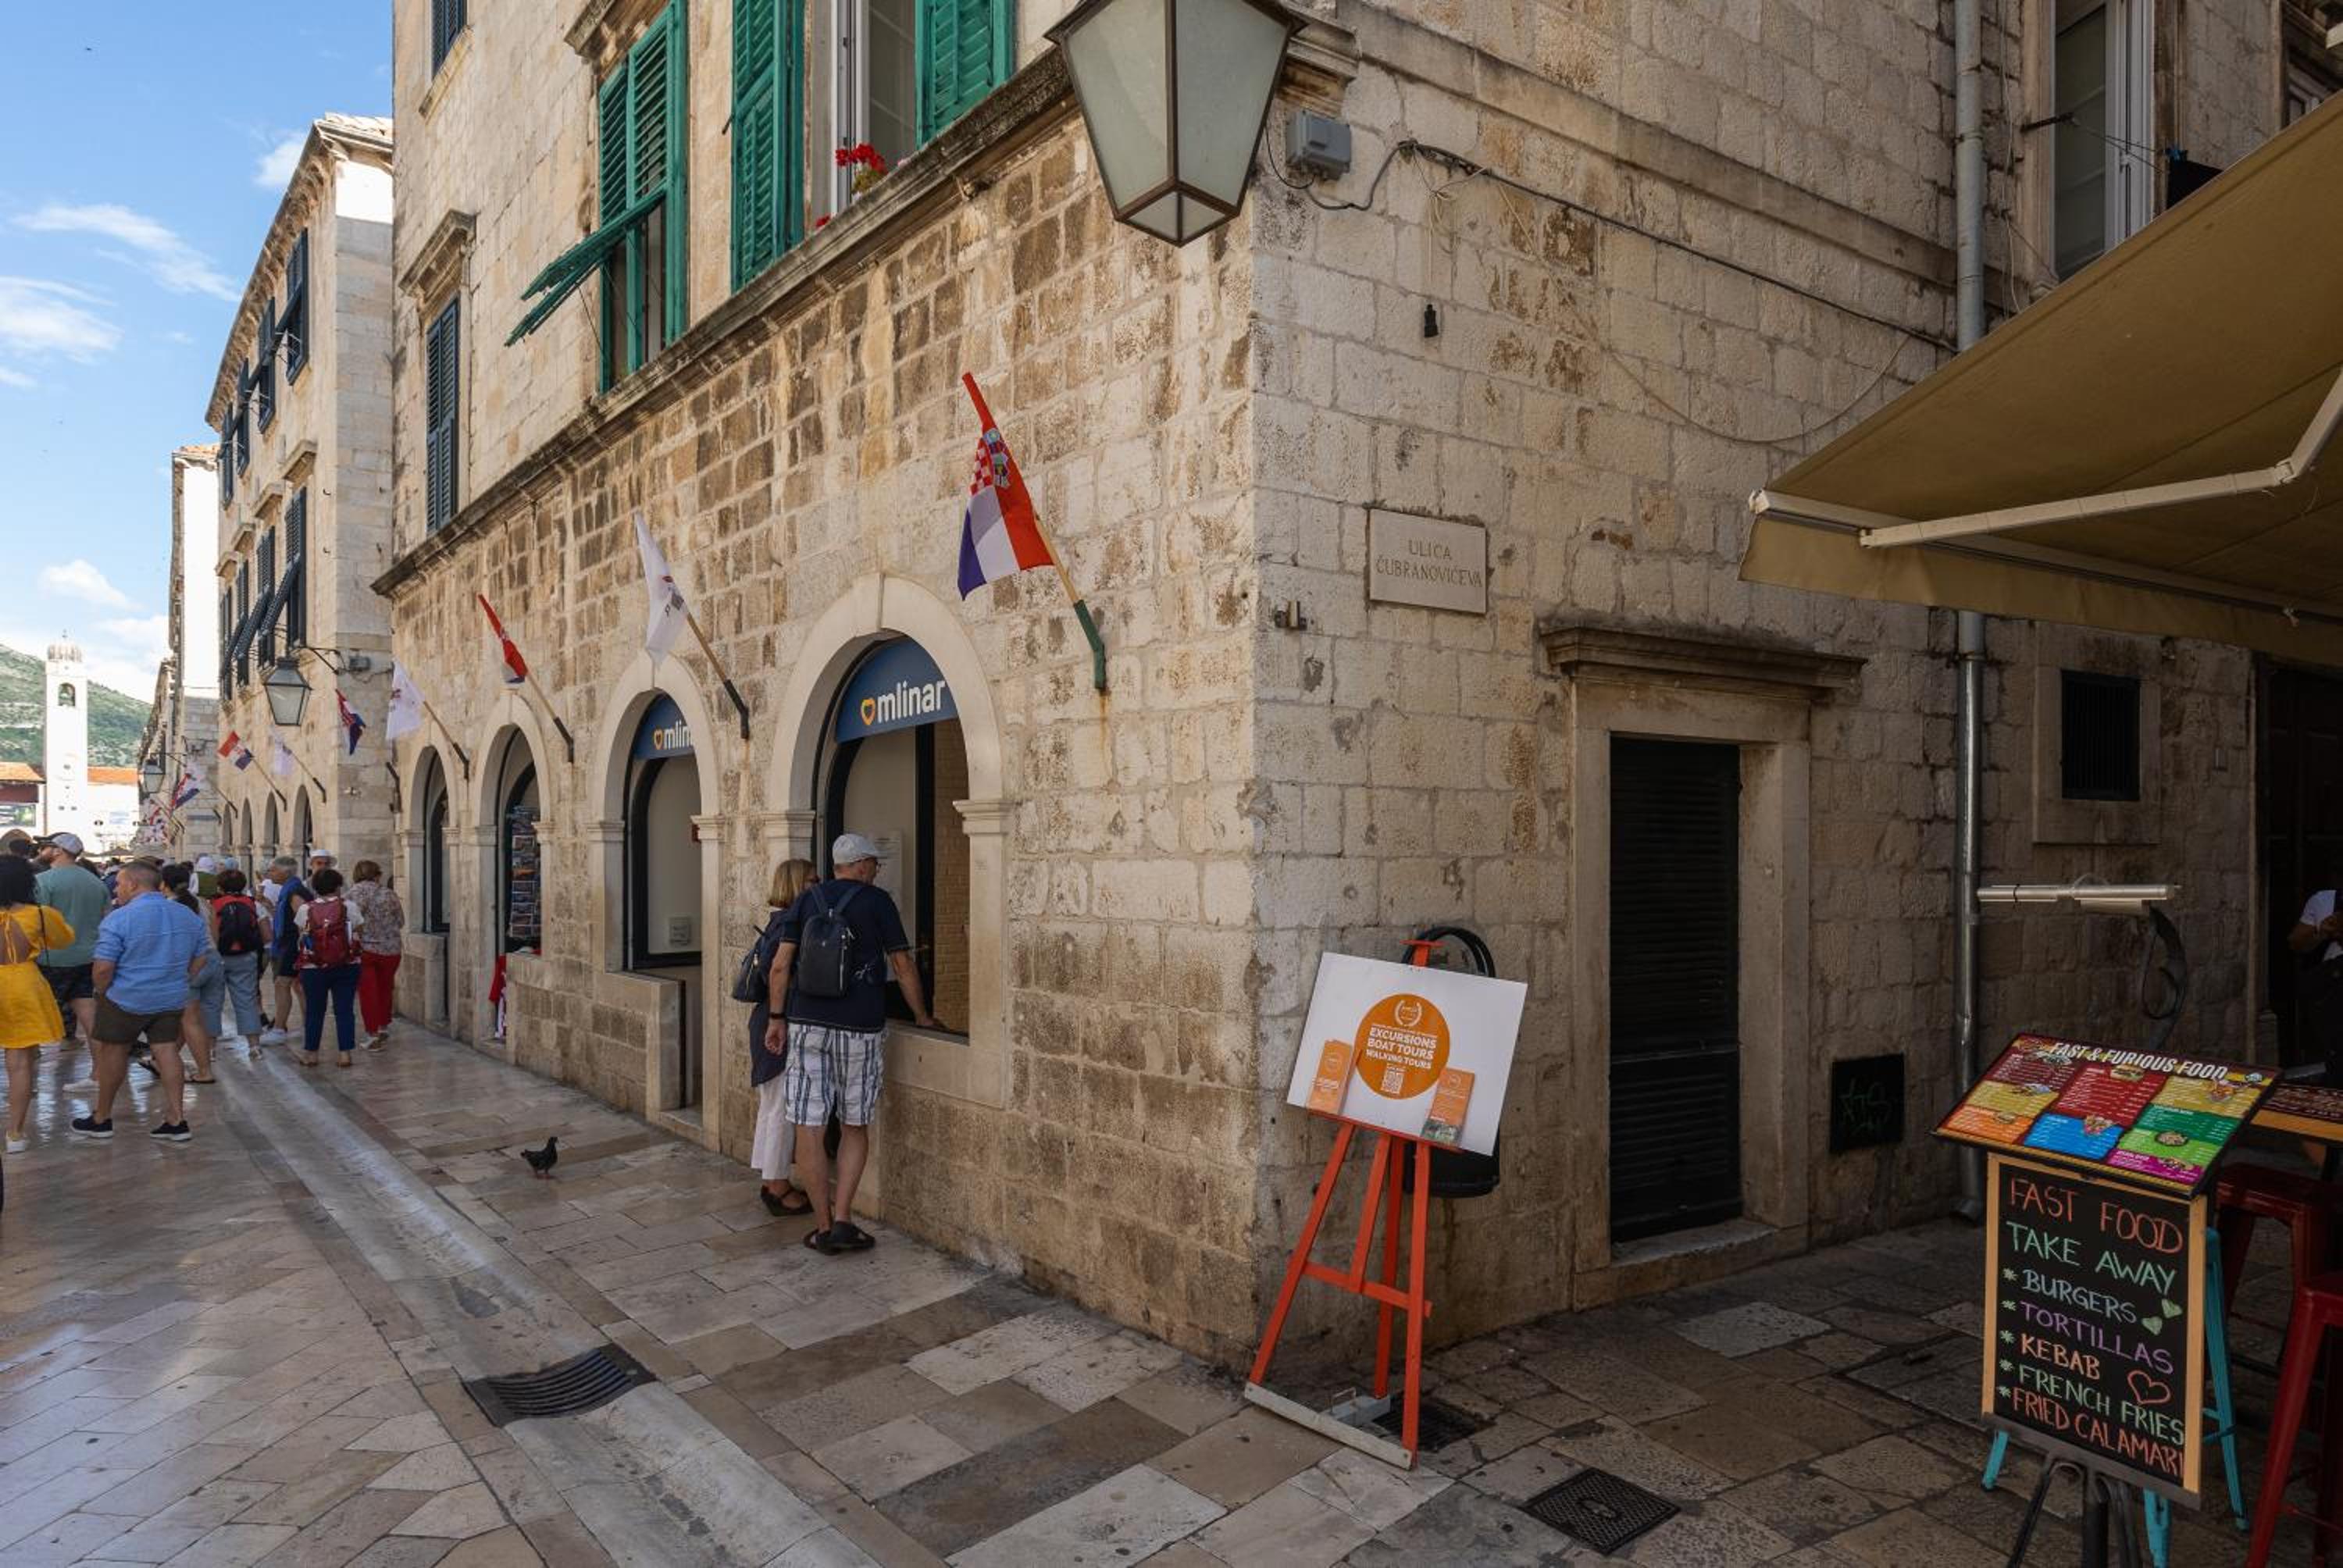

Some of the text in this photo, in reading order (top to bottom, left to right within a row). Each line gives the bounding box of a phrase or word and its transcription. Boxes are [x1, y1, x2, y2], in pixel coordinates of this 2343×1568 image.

[1408, 540, 1452, 561] ULICA
[877, 680, 946, 724] mlinar
[664, 719, 691, 750] mlin
[1366, 1049, 1403, 1062] WALKING
[1404, 1057, 1432, 1069] TOURS
[1368, 1038, 1435, 1060] BOAT TOURS
[1369, 1027, 1437, 1049] EXCURSIONS
[2049, 1042, 2228, 1080] FAST & FURIOUS FOOD
[2010, 1177, 2184, 1254] FAST FOOD
[2006, 1221, 2176, 1295] TAKE AWAY
[2021, 1268, 2138, 1324] BURGERS
[2020, 1300, 2174, 1375] TORTILLAS
[2020, 1332, 2101, 1381] KEBAB
[2010, 1387, 2070, 1431] FRIED
[2018, 1363, 2184, 1445] FRENCH FRIES
